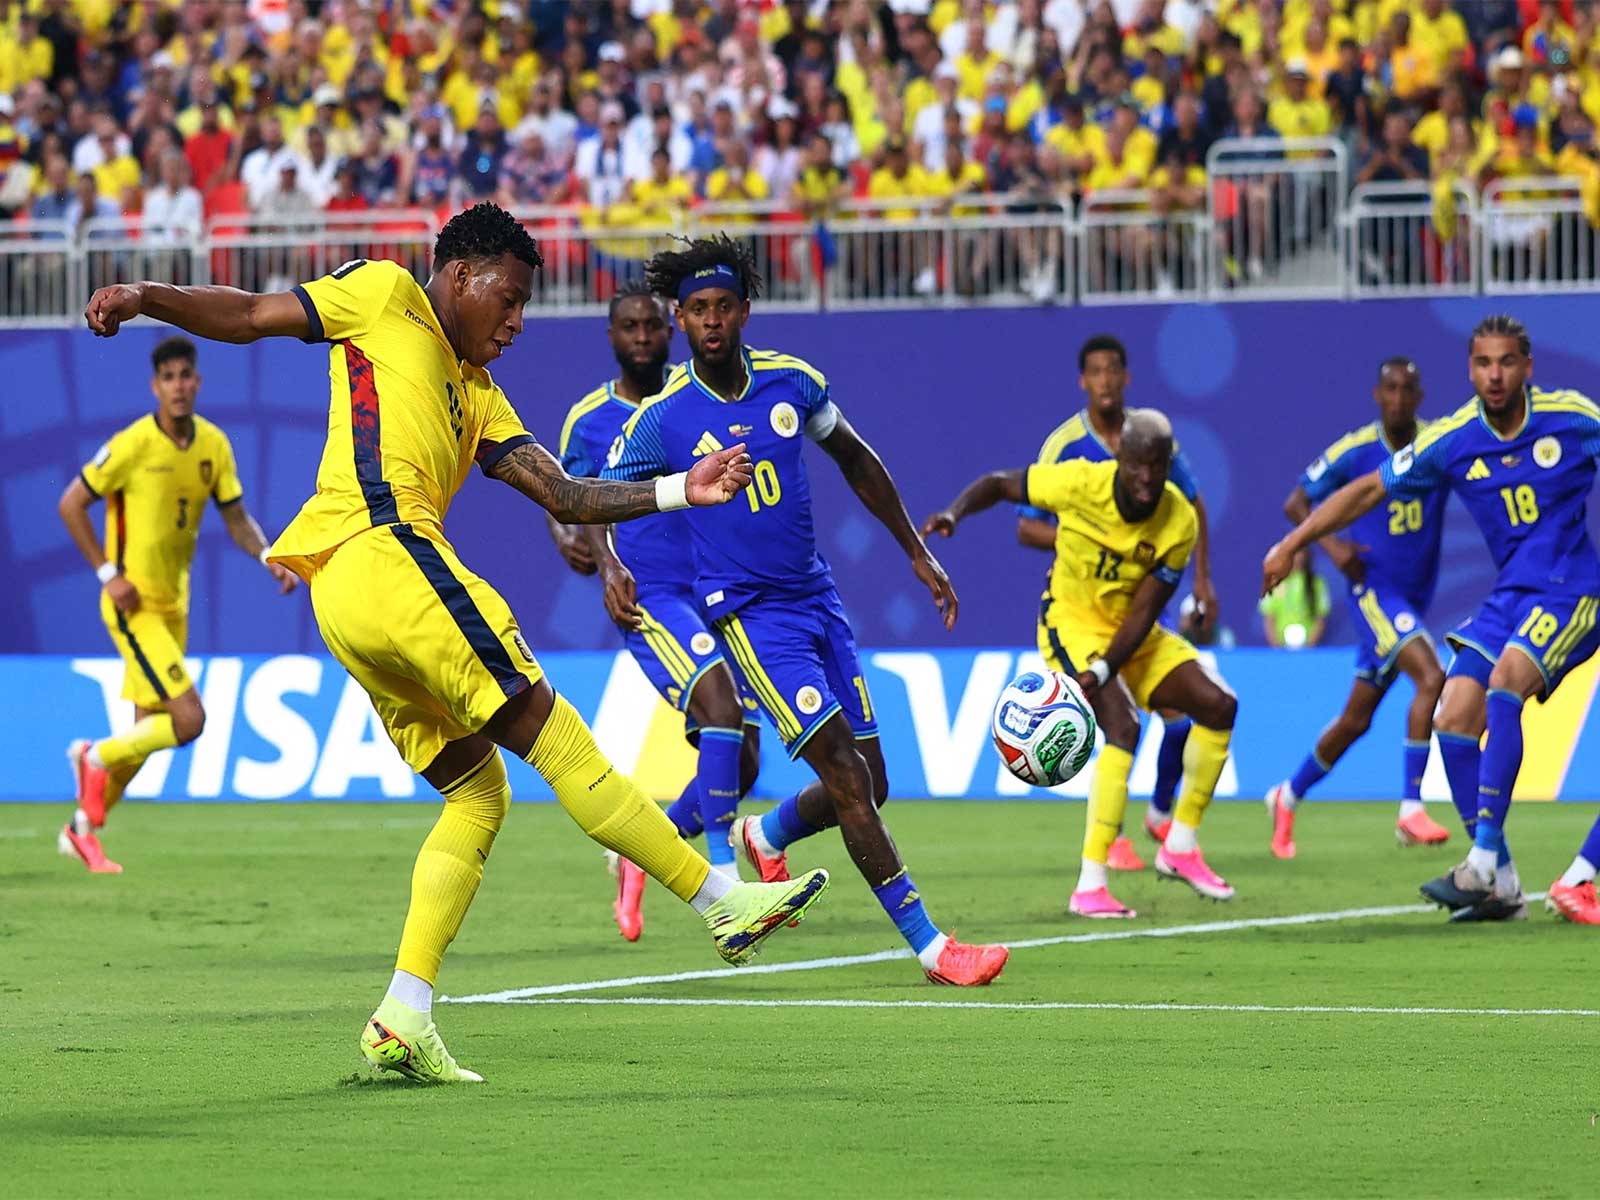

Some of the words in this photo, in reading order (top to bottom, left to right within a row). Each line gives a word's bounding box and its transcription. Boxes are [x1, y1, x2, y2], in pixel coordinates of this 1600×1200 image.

[746, 460, 781, 513] 10
[1500, 485, 1540, 527] 18
[176, 498, 188, 529] 3
[1388, 499, 1423, 535] 20
[1095, 550, 1124, 582] 13
[1518, 606, 1559, 648] 18
[71, 654, 416, 800] VISA
